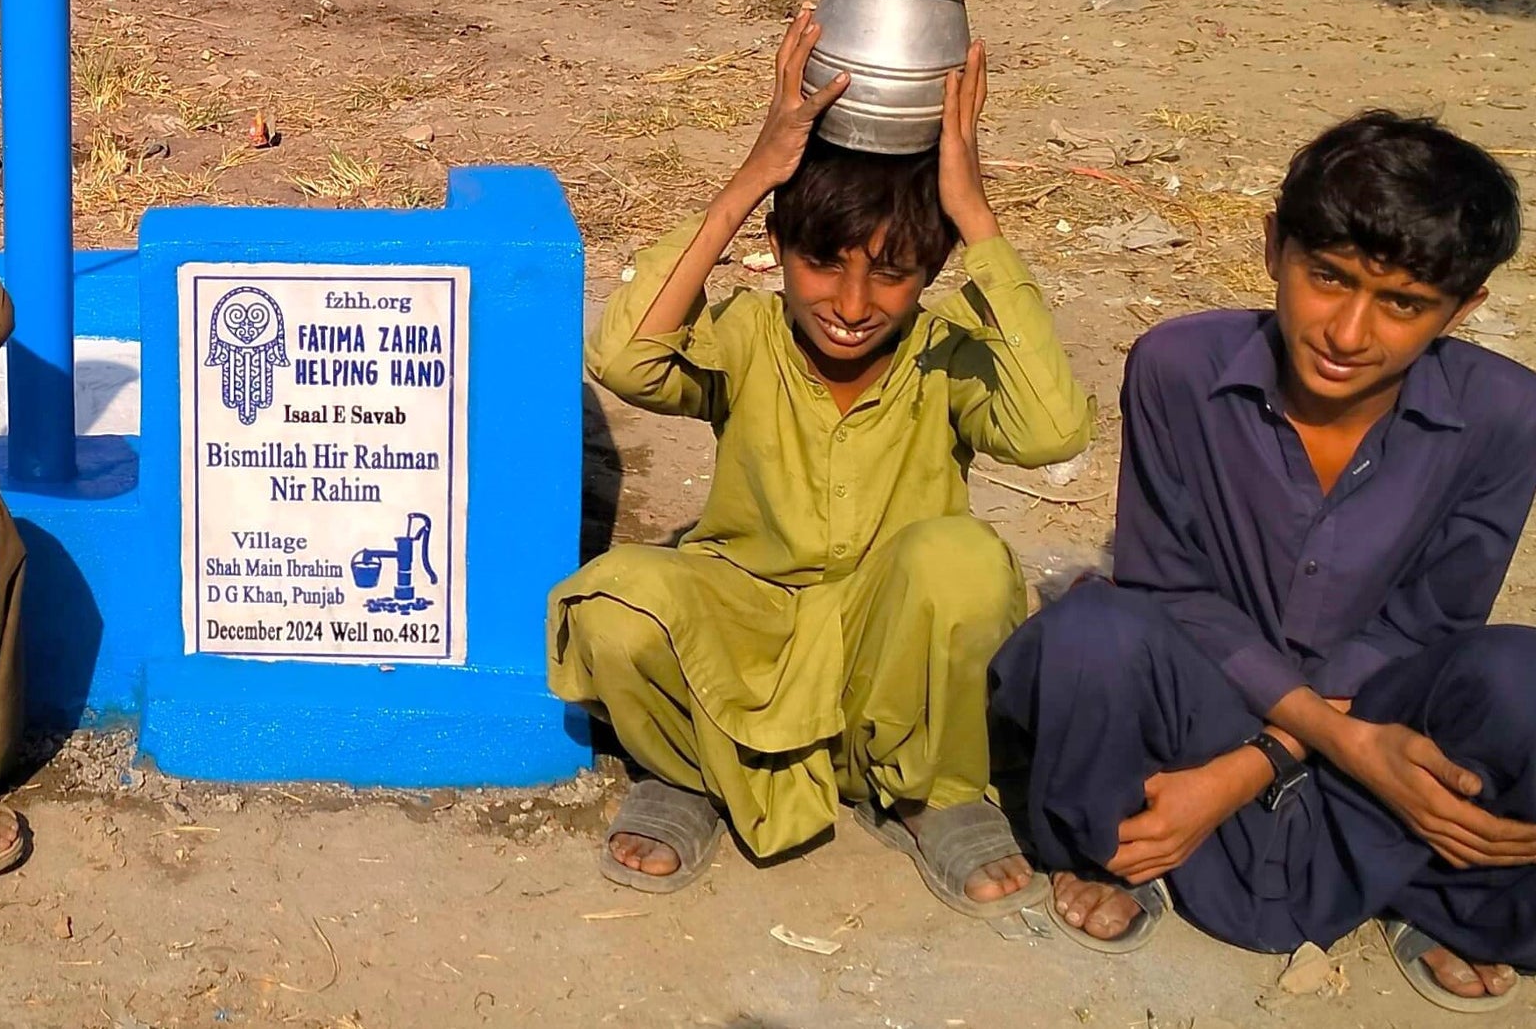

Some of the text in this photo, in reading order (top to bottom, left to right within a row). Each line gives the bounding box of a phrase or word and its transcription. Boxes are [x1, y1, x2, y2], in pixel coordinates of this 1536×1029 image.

[325, 292, 411, 313] fzhh.org
[298, 325, 442, 354] FATIMA ZAHRA
[295, 360, 445, 387] HELPING HAND
[284, 405, 406, 425] Isaal E Savab
[207, 443, 438, 470] Bismillah Hir Rahman
[271, 477, 381, 502] Nir Rahim
[232, 532, 307, 552] Village
[207, 559, 343, 578] Shah Main Ibrahim
[207, 586, 345, 609] D G Khan, Punjab
[207, 620, 440, 644] December 2024 Well no.4812
